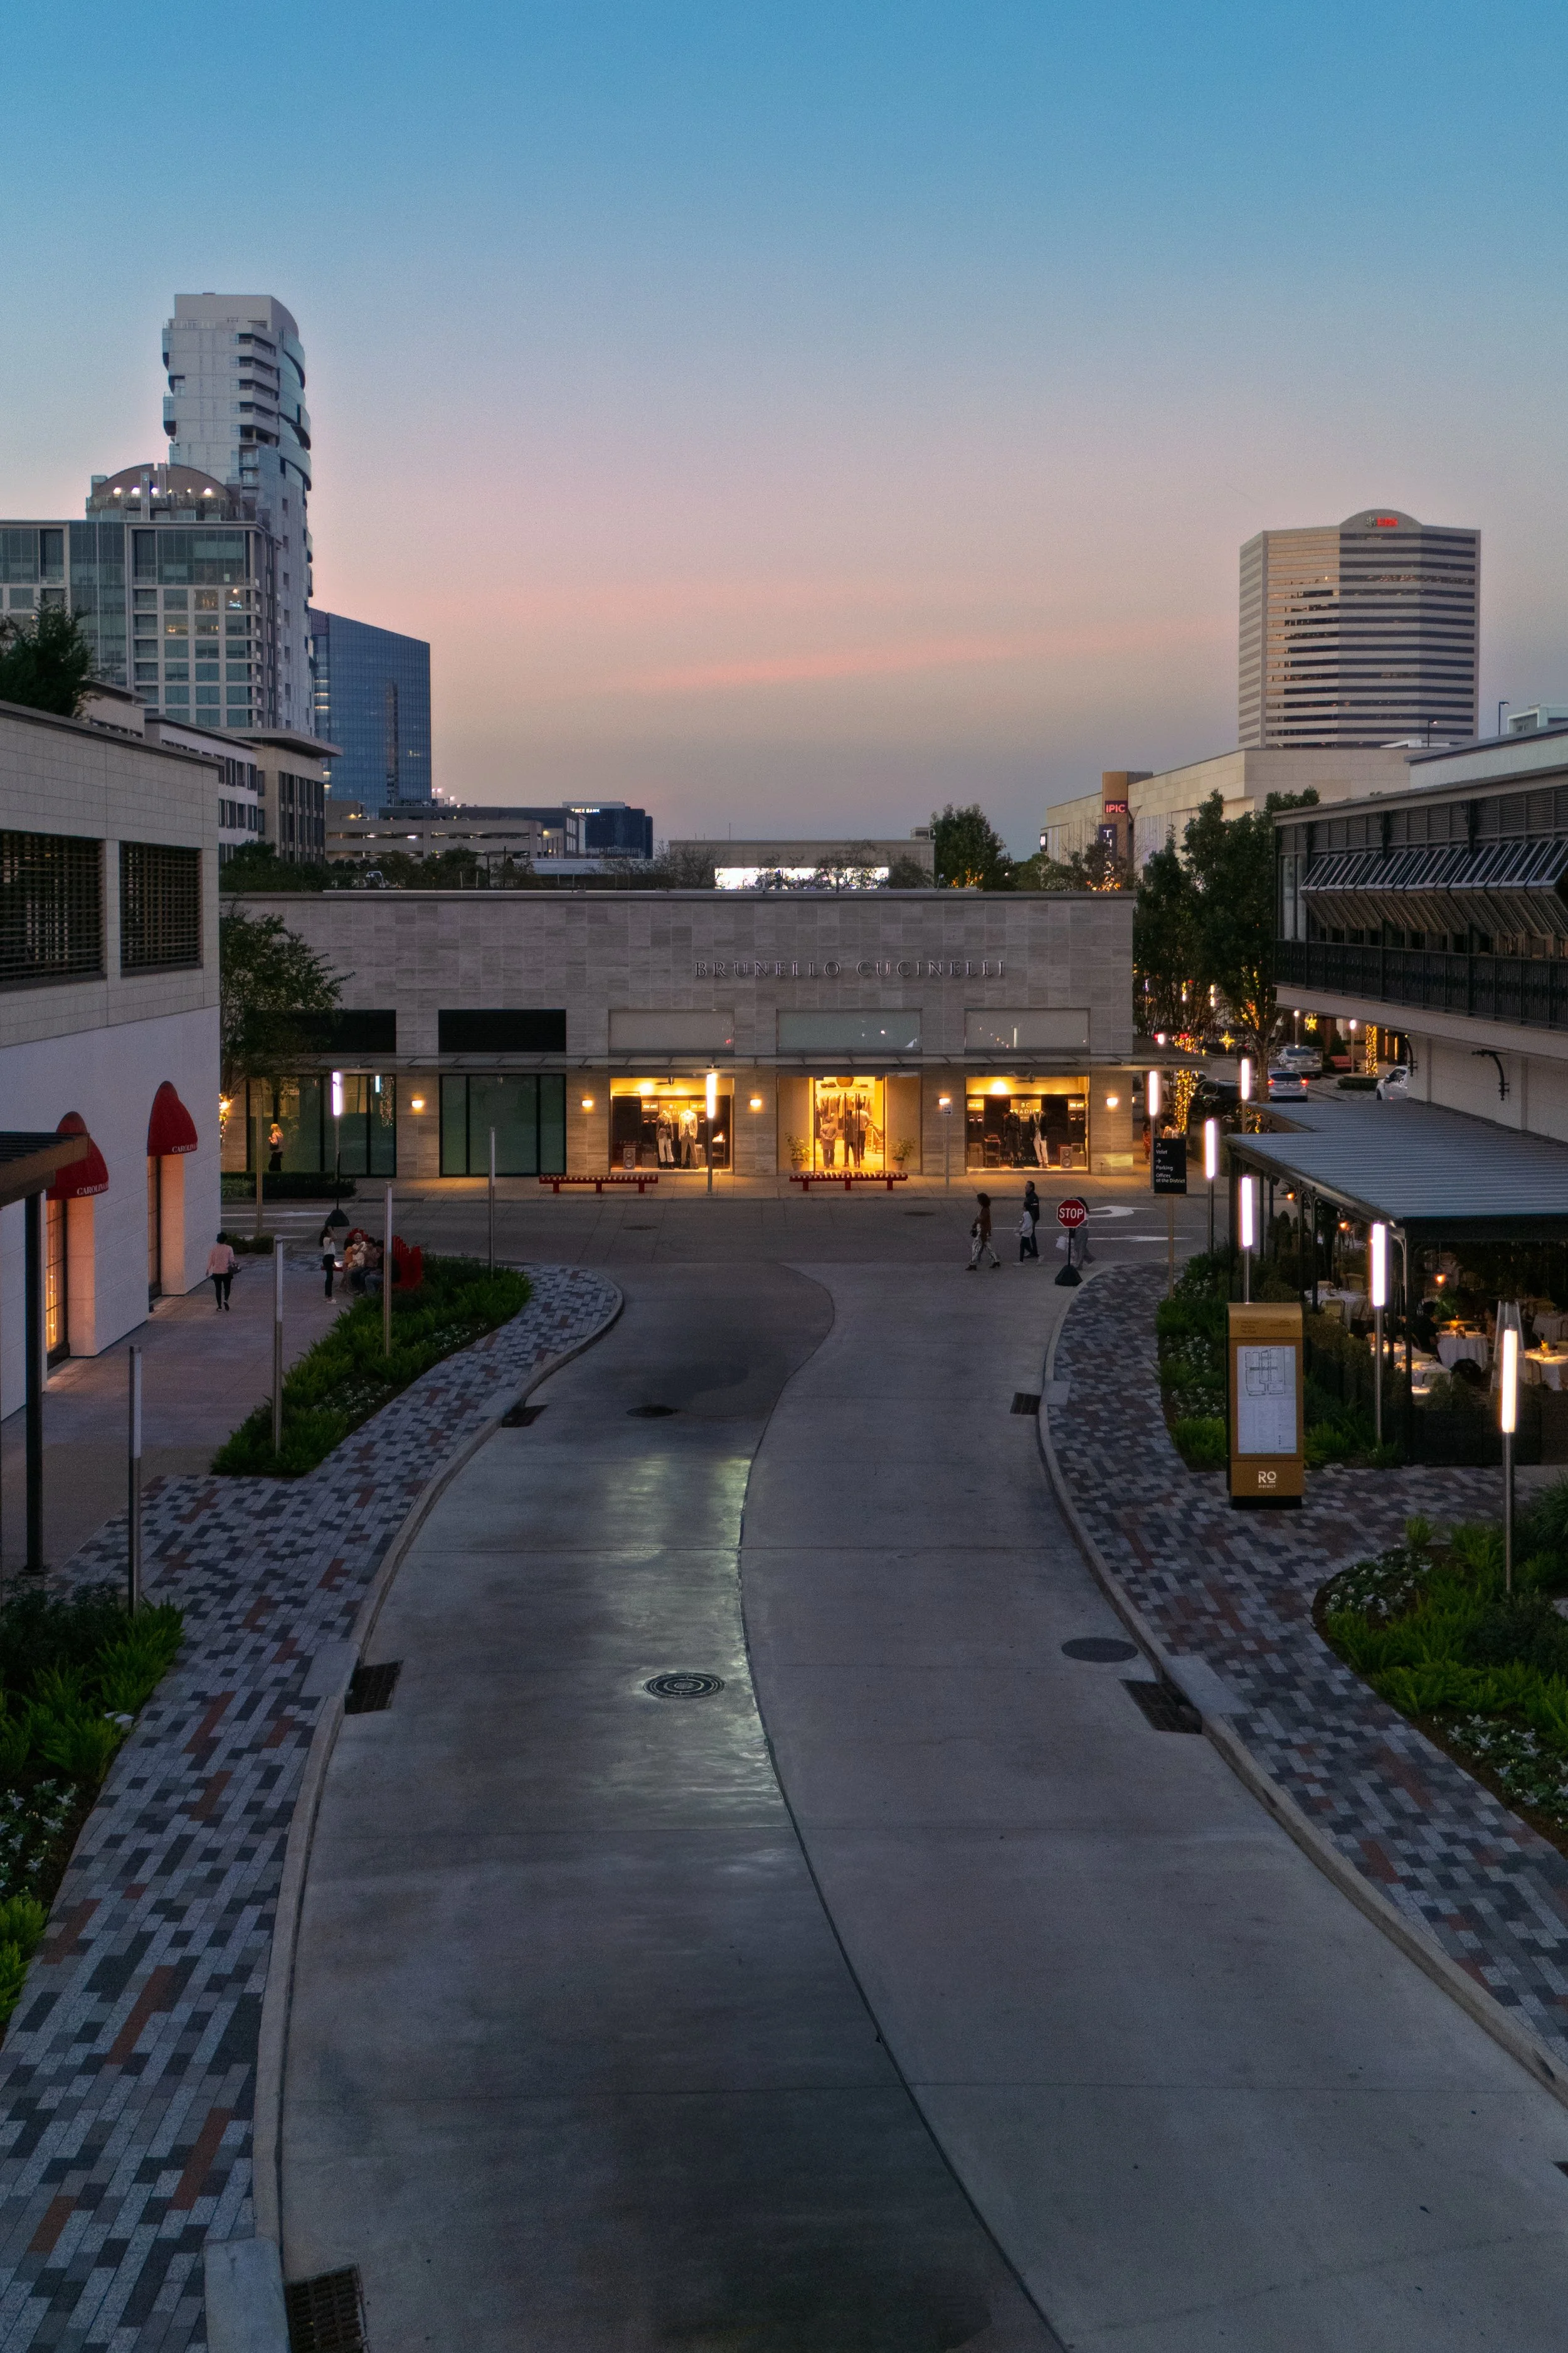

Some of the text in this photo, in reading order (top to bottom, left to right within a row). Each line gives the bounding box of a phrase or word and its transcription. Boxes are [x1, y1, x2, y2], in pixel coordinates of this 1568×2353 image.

[1106, 804, 1125, 813] IPIC
[695, 960, 1004, 977] BRUNELLO CUCINELLI
[1059, 1208, 1084, 1219] STOP
[1258, 1471, 1276, 1483] RO
